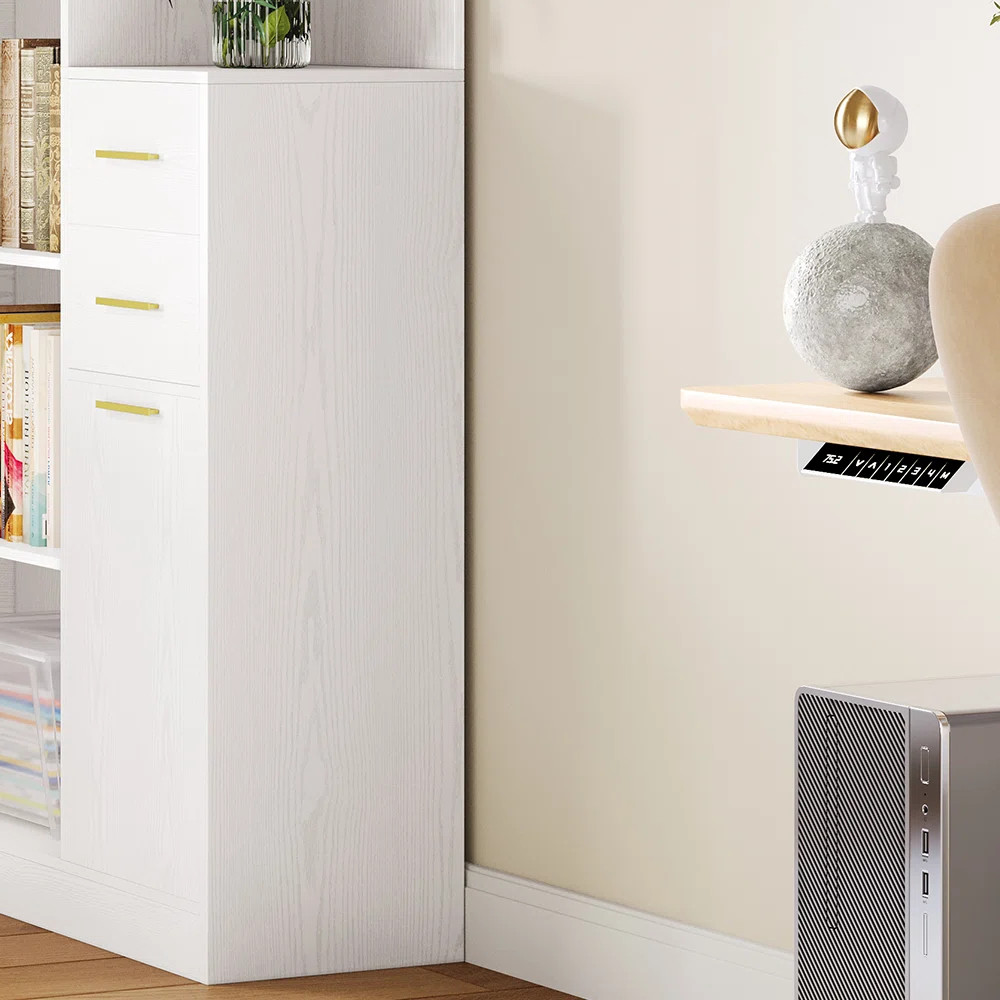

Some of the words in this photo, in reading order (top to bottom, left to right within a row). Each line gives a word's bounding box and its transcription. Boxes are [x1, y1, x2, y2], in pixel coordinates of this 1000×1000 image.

[822, 453, 843, 465] 752
[884, 462, 892, 471] 1
[897, 464, 908, 474] 2
[911, 466, 921, 475] 3
